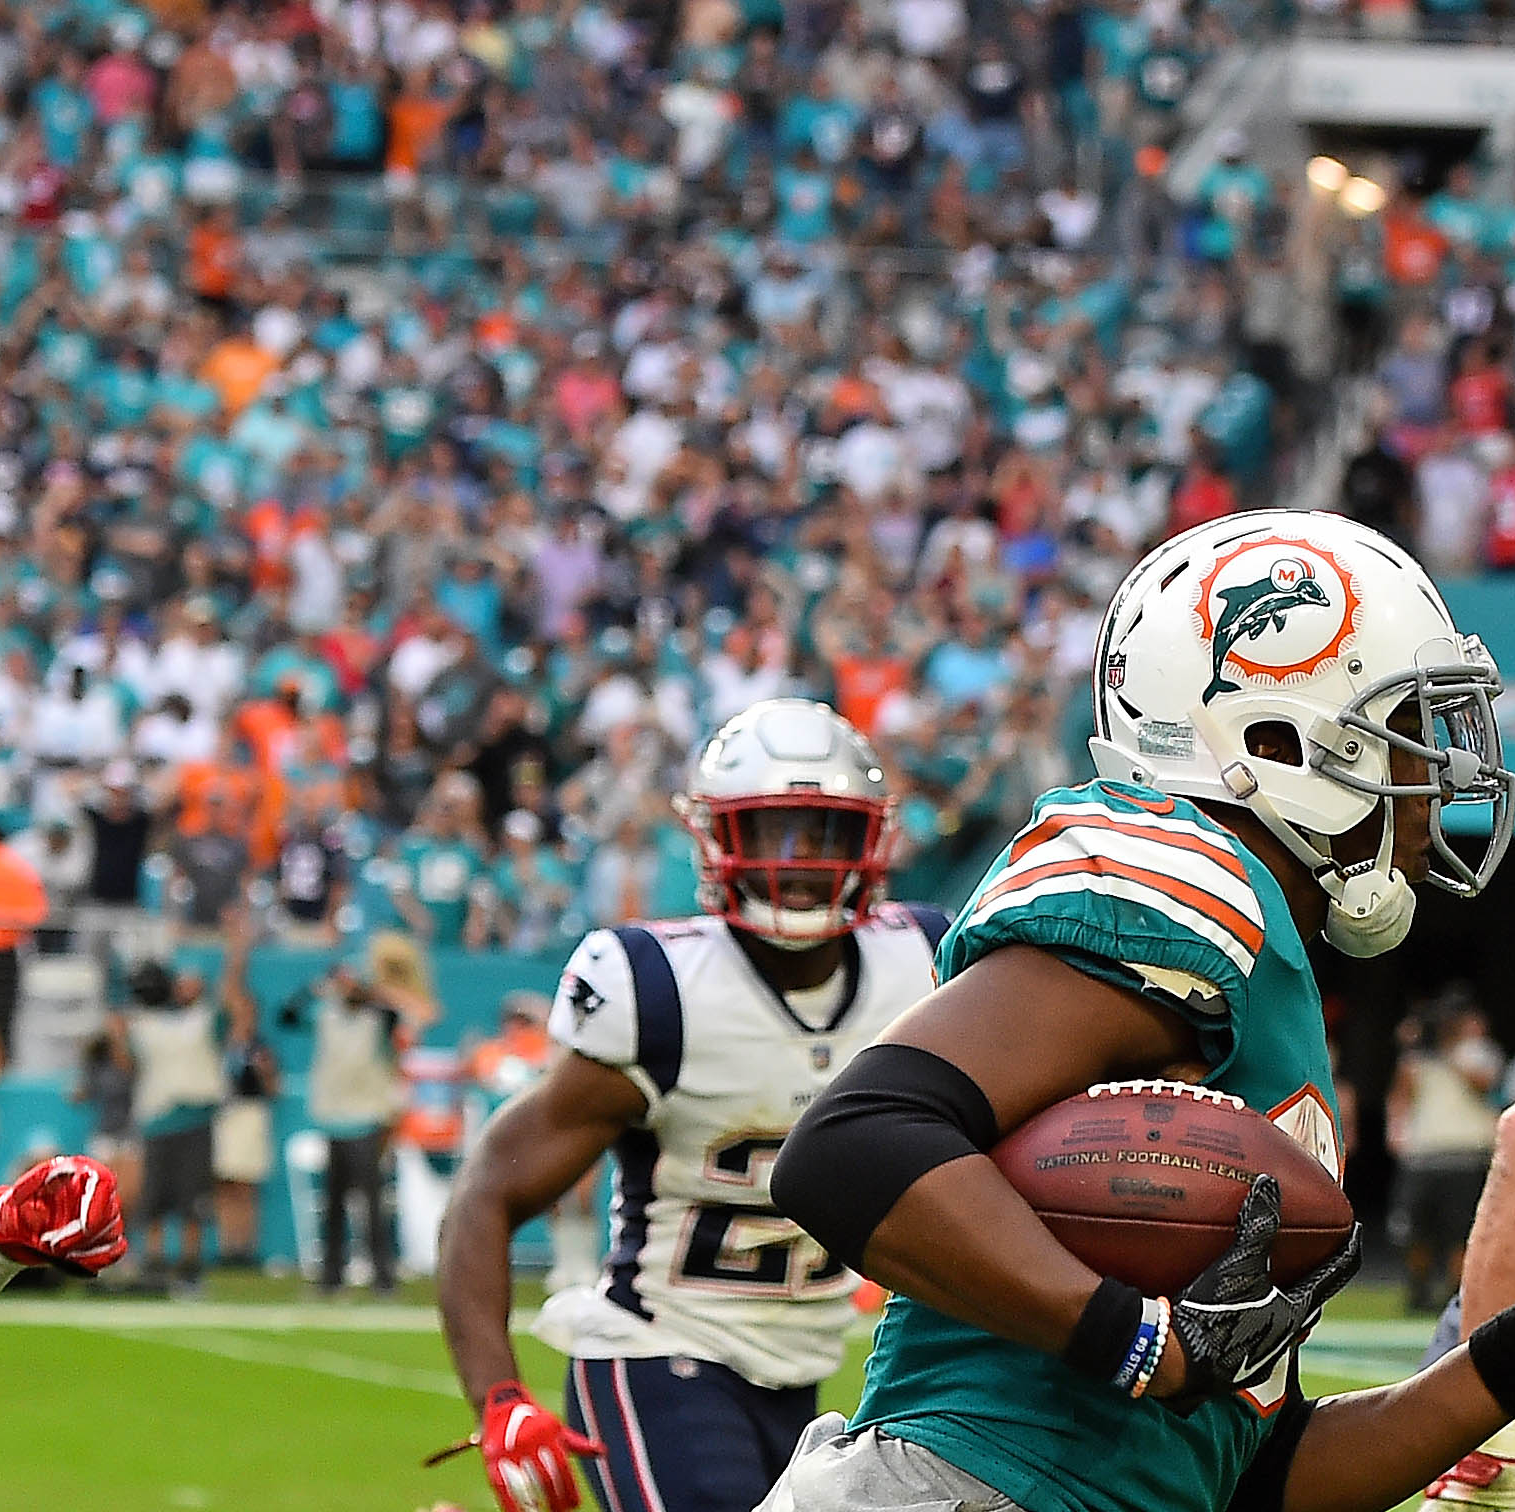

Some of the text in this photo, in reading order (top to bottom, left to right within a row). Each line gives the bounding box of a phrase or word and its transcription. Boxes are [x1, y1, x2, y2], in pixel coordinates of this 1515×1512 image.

[1277, 568, 1296, 583] M
[1036, 1151, 1110, 1171] NATIONAL
[1116, 1149, 1202, 1171] FOOTBALL
